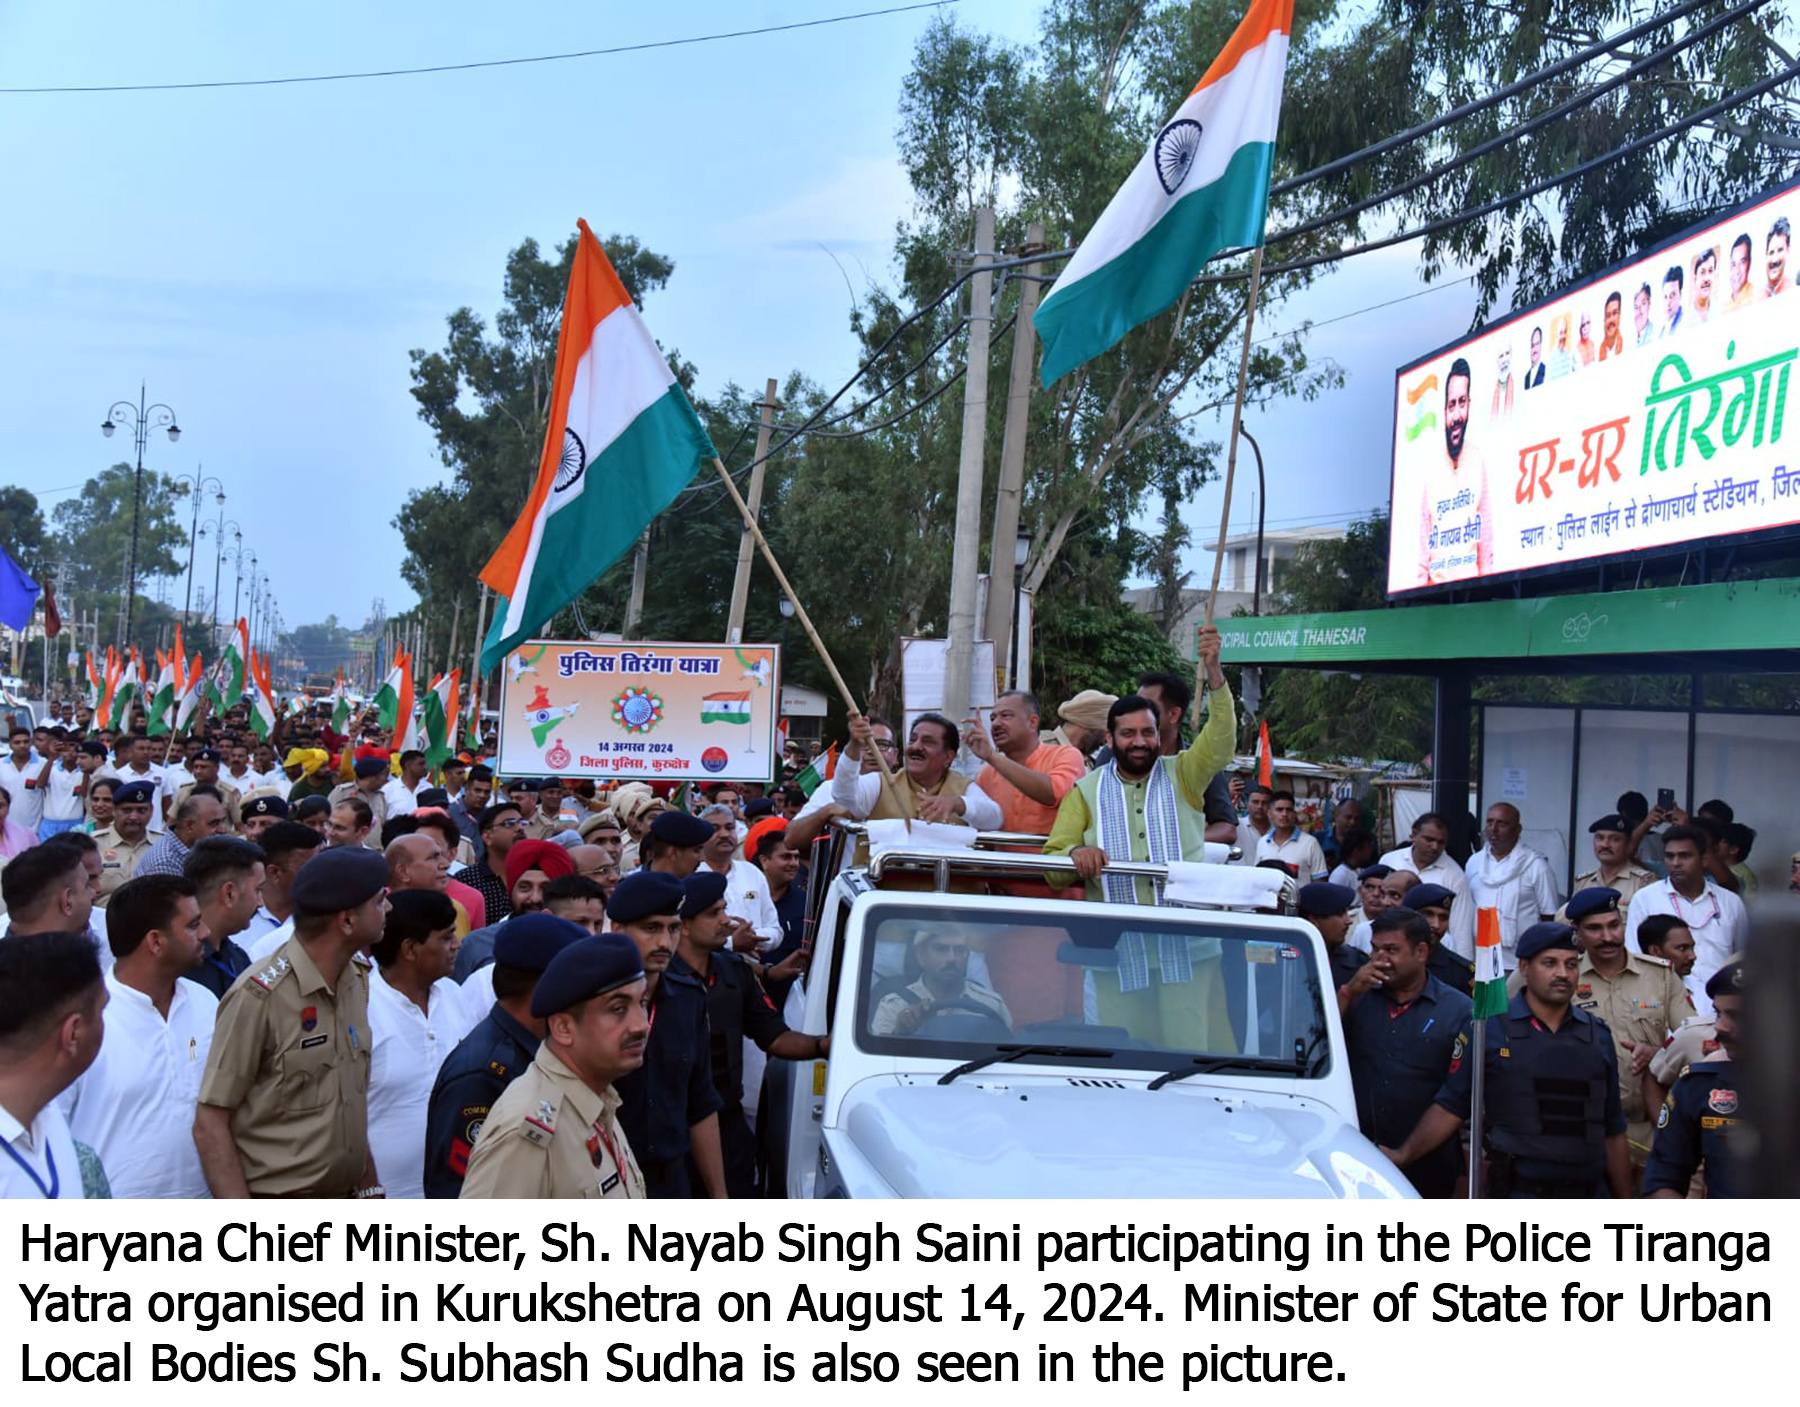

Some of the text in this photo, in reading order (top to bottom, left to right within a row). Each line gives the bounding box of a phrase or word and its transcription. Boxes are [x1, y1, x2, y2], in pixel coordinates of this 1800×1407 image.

[1515, 340, 1799, 504] घर-घर तिरंगा
[1521, 526, 1545, 548] स्थान
[1557, 513, 1587, 550] पुलिस
[1591, 501, 1620, 537] लाईन
[1624, 498, 1637, 528] से
[1641, 482, 1698, 527] द्रोणाचार्य
[1428, 524, 1439, 550] श्री
[1463, 514, 1482, 543] सैनी
[1253, 629, 1299, 648] COUNCIL
[1303, 627, 1367, 646] THANESAR
[559, 651, 721, 677] पुलिस तिरंगा यात्रा
[598, 742, 673, 753] 14 अगस्त 2024
[580, 755, 609, 768] जिला
[463, 1106, 488, 1116] COMM
